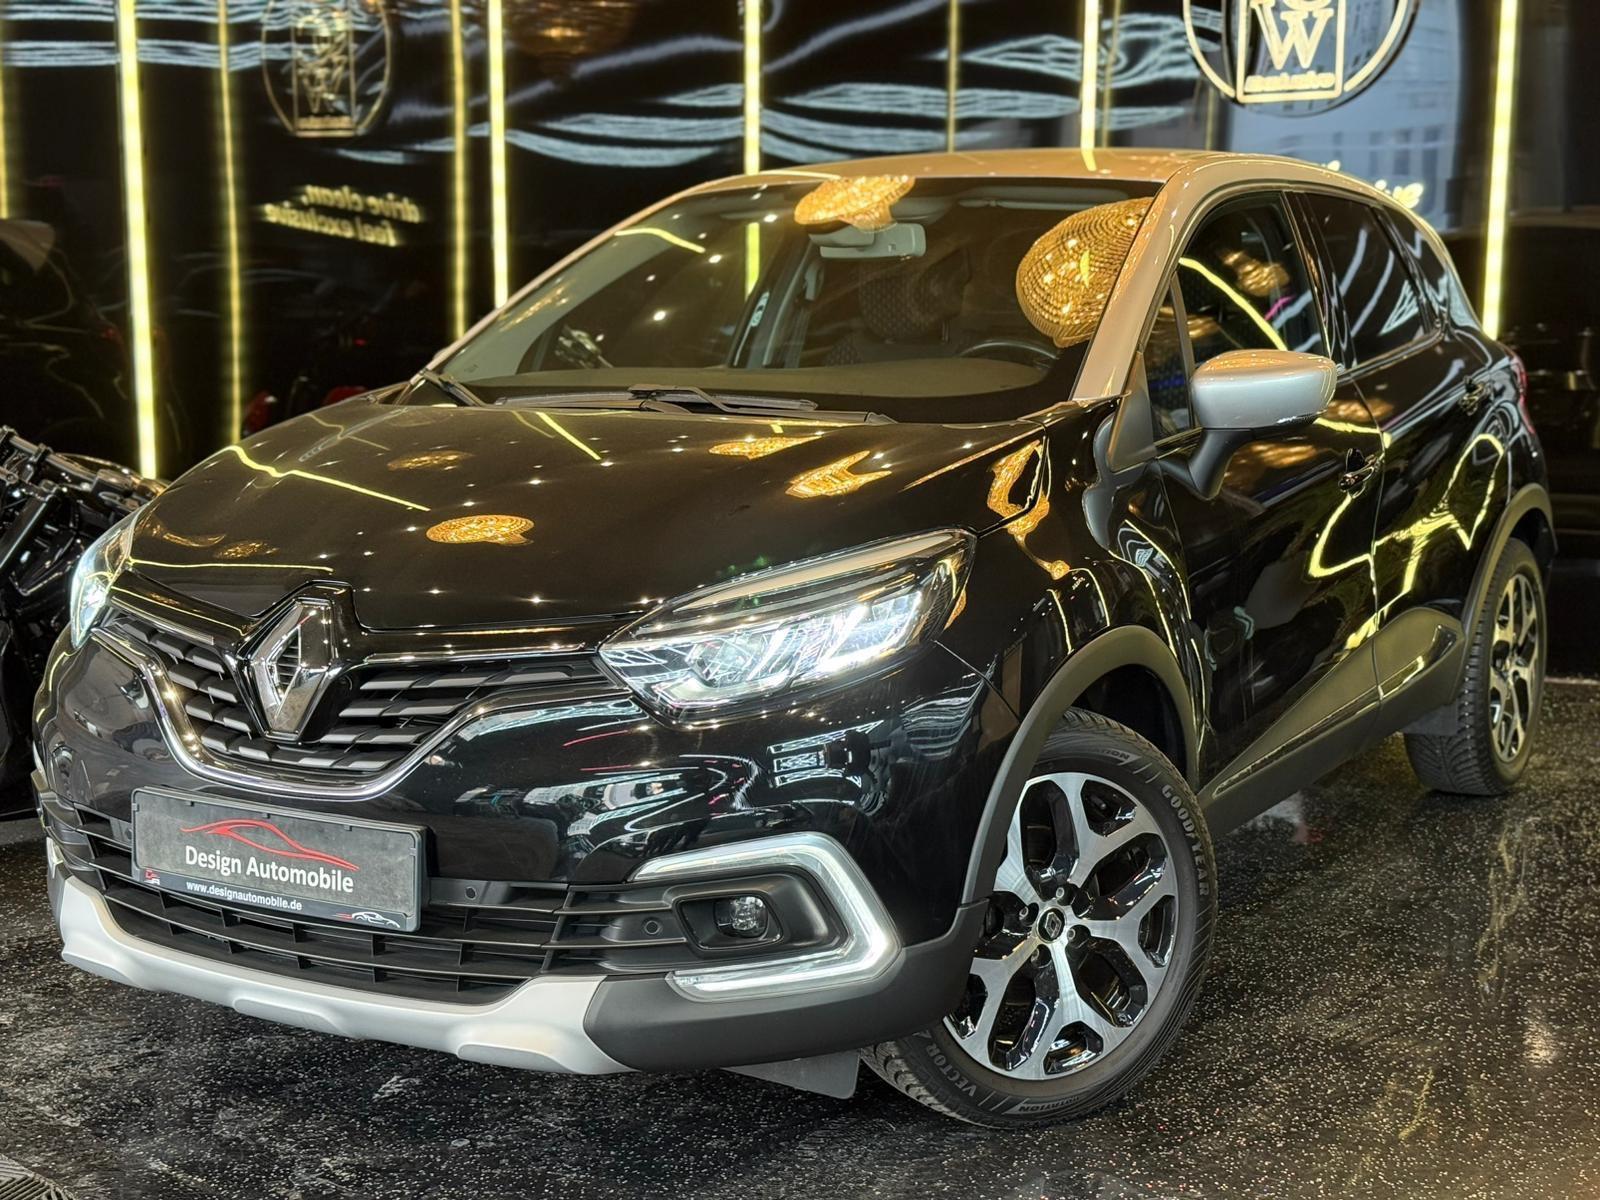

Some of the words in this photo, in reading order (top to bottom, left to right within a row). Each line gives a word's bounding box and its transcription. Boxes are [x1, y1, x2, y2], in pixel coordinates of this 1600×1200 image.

[185, 845, 242, 877] Design
[246, 856, 354, 893] Automobile
[186, 880, 303, 911] www.designautomobile.de
[926, 1043, 977, 1097] VECTOR
